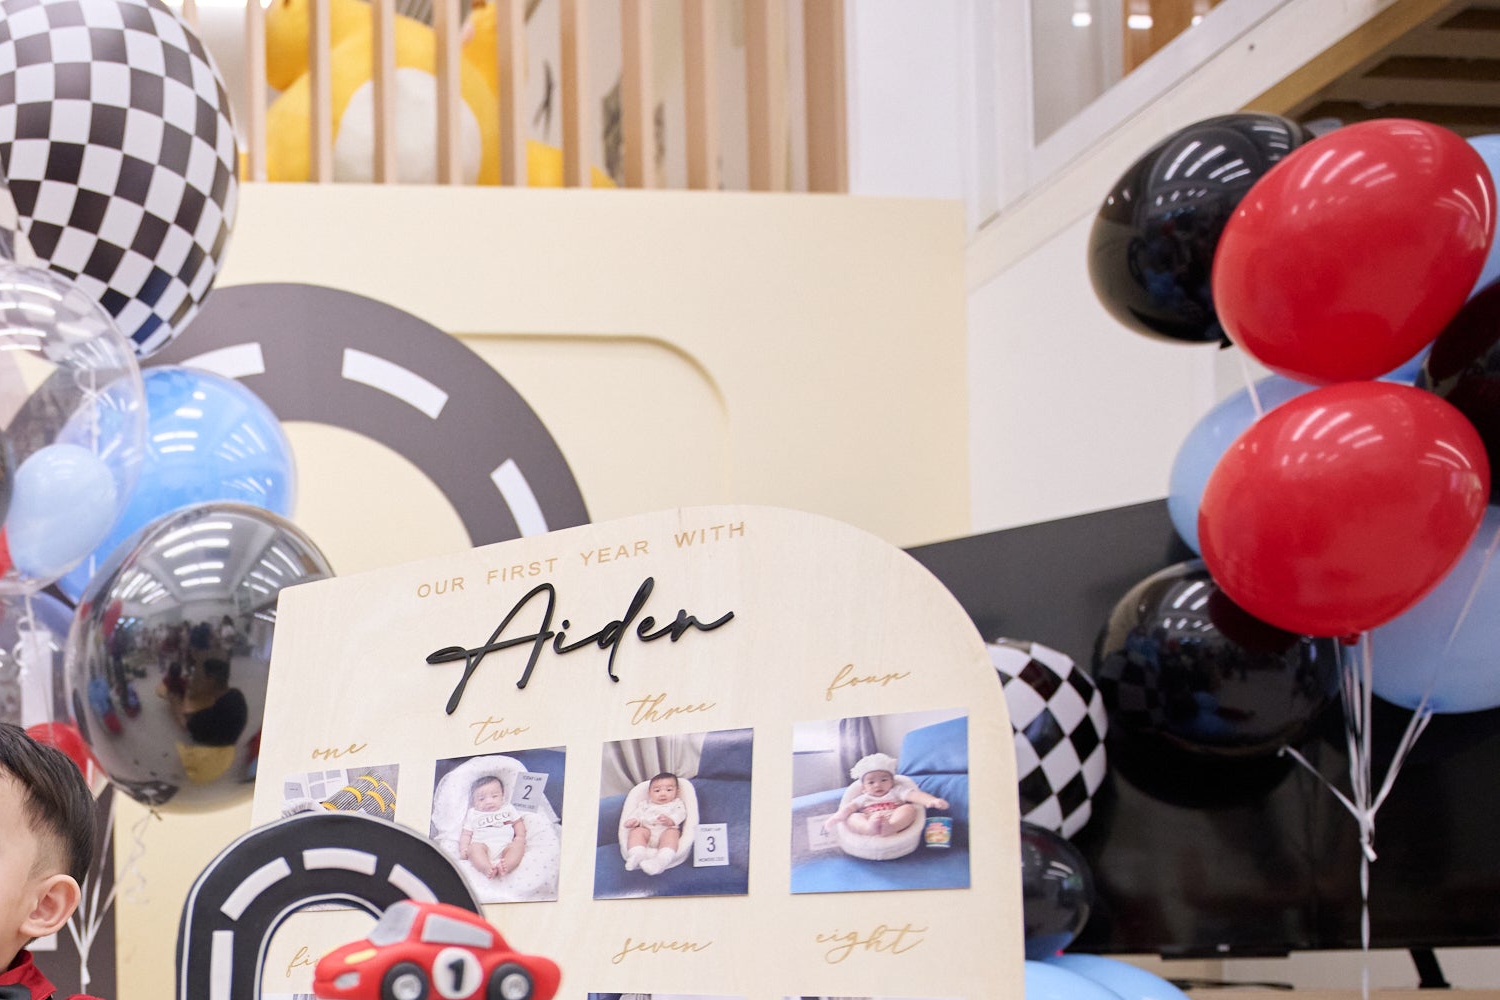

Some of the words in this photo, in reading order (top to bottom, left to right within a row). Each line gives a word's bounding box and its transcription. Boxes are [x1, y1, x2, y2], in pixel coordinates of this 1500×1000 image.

[416, 576, 466, 598] OUR
[486, 557, 559, 585] FIRST
[580, 540, 650, 567] YEAR
[674, 521, 746, 549] WITH
[426, 576, 735, 715] Aiden
[825, 662, 911, 701] four
[626, 692, 717, 727] three
[469, 716, 531, 747] two
[311, 743, 368, 760] one
[521, 784, 533, 800] 2
[706, 836, 716, 853] 3
[611, 937, 713, 965] seven
[816, 923, 928, 964] eight
[446, 958, 467, 993] 1
